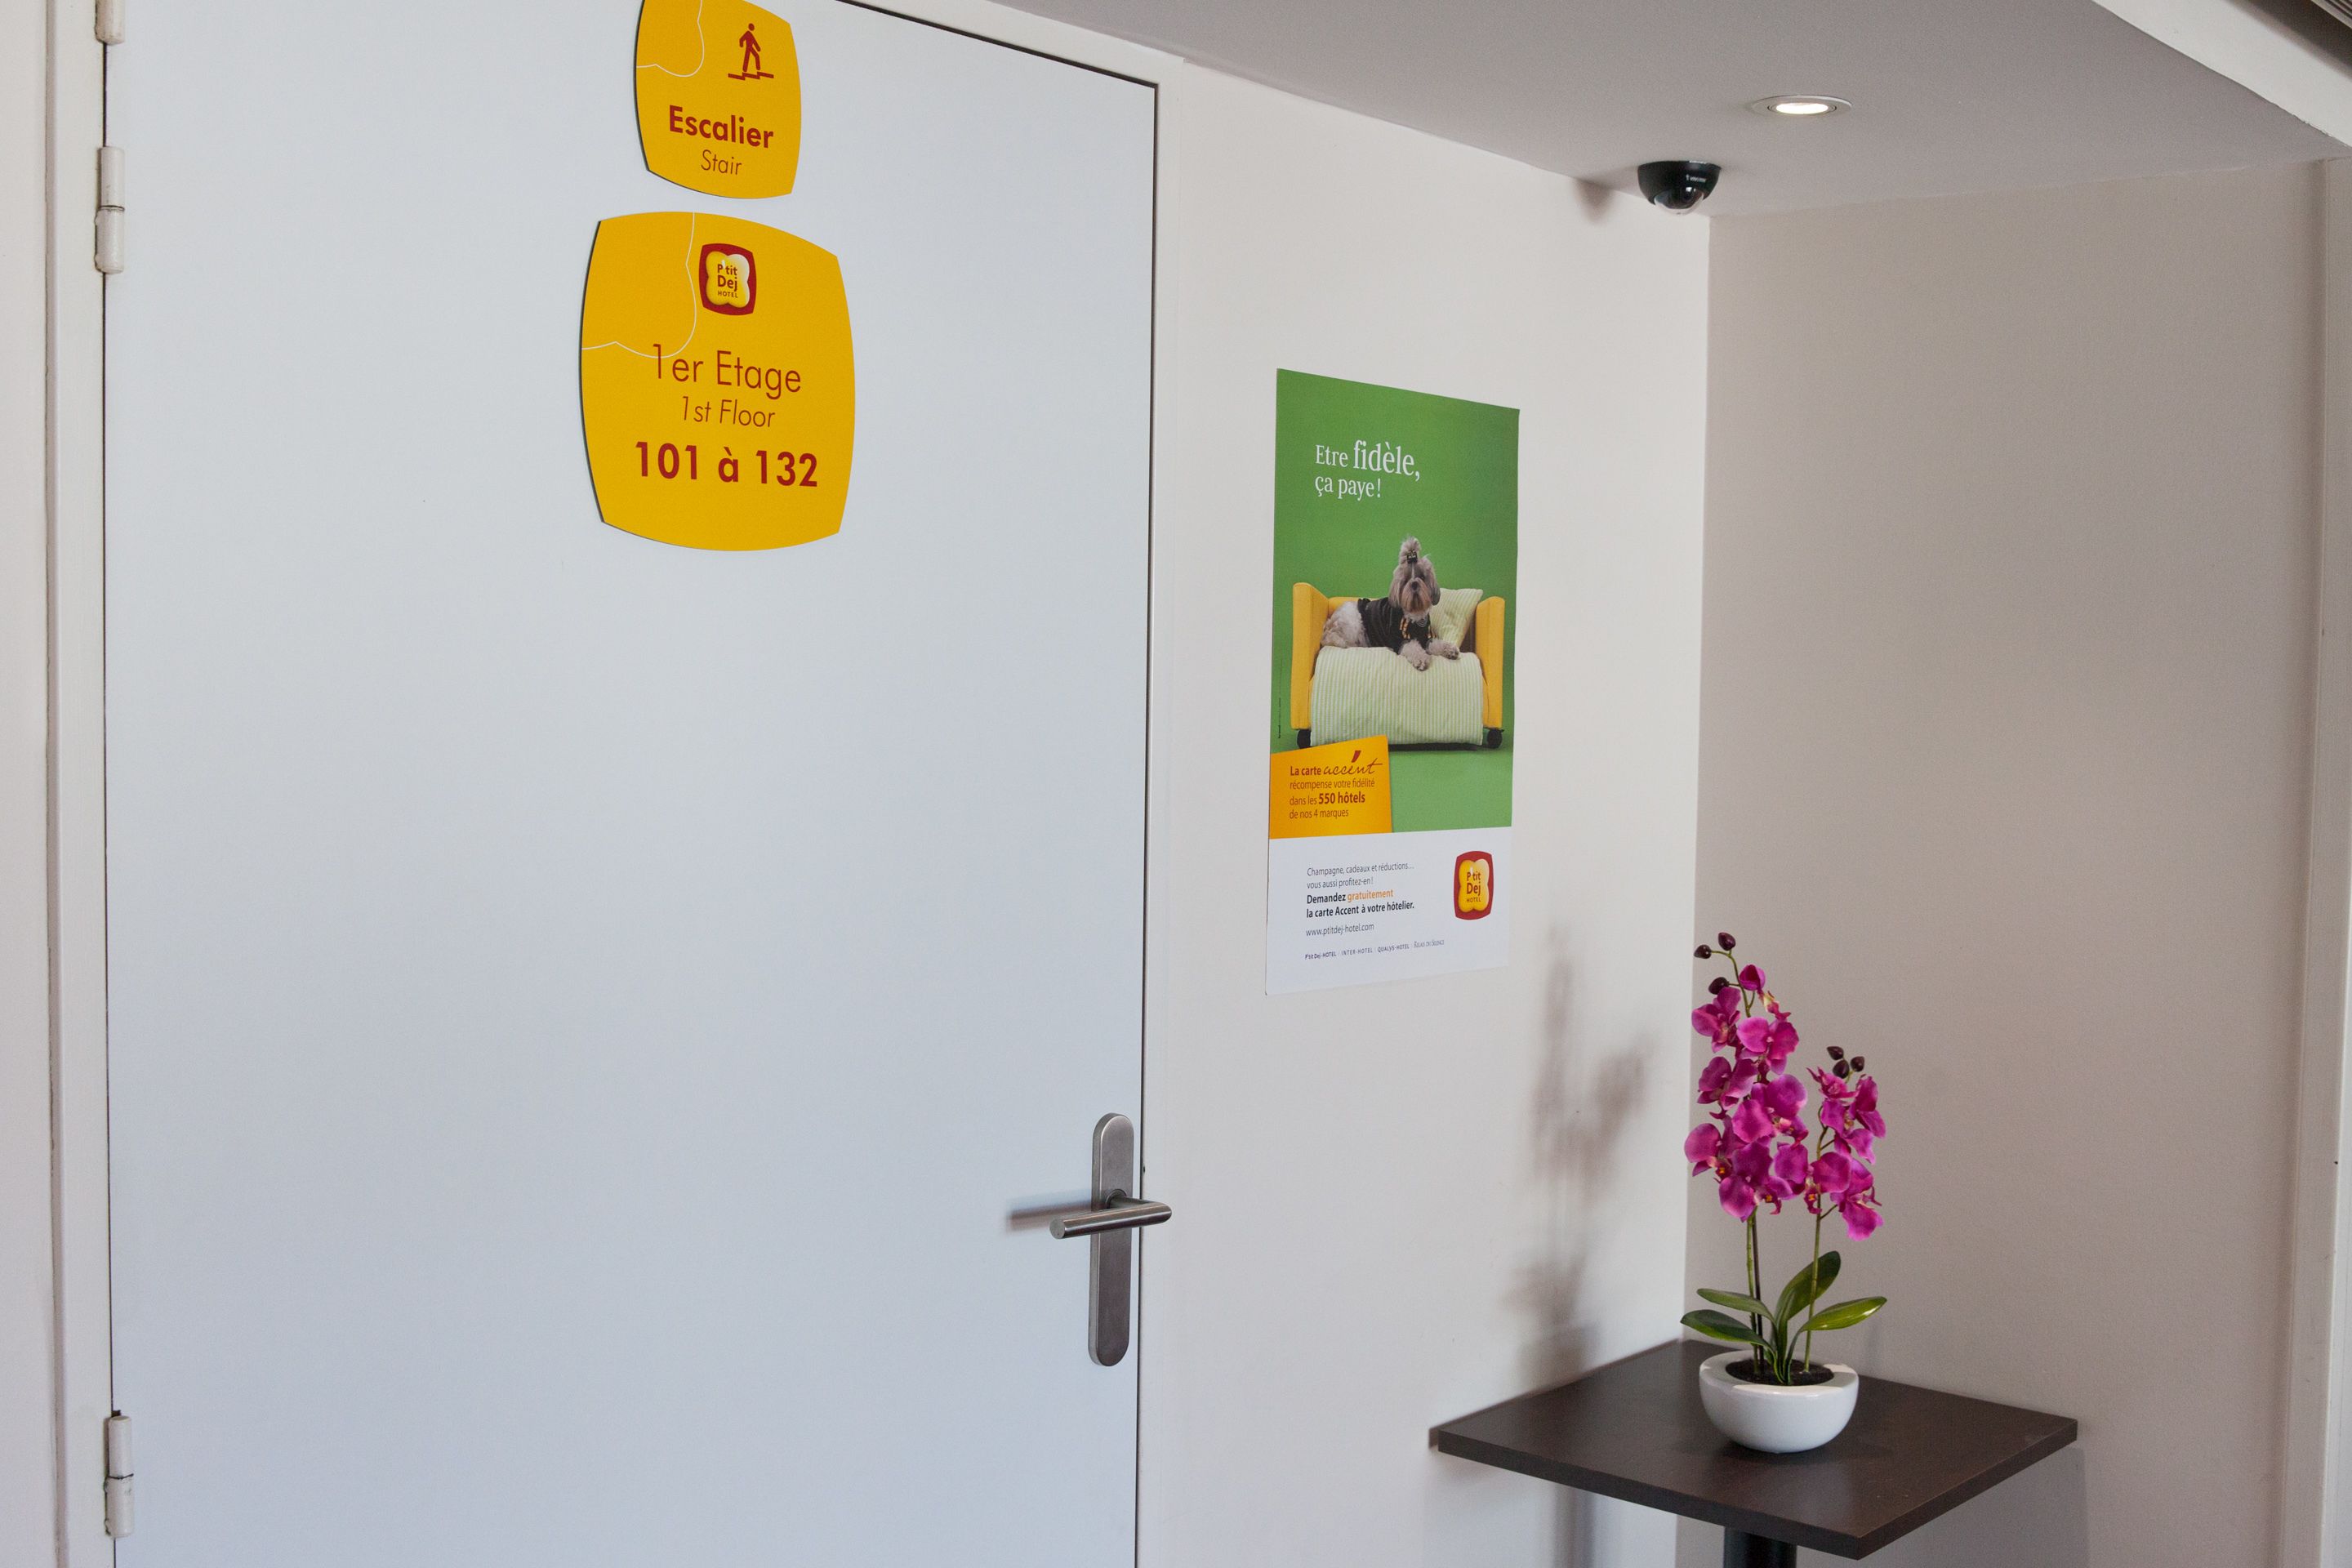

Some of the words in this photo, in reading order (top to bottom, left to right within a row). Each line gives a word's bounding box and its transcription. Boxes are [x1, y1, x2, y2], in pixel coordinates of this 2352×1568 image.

[669, 104, 774, 149] Escalier
[701, 149, 742, 176] Stair
[717, 274, 737, 292] Dej
[653, 343, 704, 382] 1er
[716, 350, 801, 400] Etage
[682, 396, 711, 423] 1st
[719, 399, 776, 428] Floor
[635, 441, 697, 480] 101
[718, 446, 739, 483] à
[755, 450, 817, 488] 132
[1315, 444, 1348, 468] Etre
[1352, 439, 1420, 482] fidèle,
[1314, 475, 1334, 497] ça
[1290, 766, 1299, 776] La
[1301, 768, 1321, 776] carte
[1290, 779, 1332, 791] récompense
[1334, 781, 1351, 789] votre
[1352, 777, 1375, 788] fidélité
[1290, 796, 1306, 805] dans
[1307, 795, 1317, 805] les
[1318, 793, 1336, 804] 550
[1338, 791, 1365, 804] hôtels
[1290, 809, 1298, 819] de
[1299, 811, 1312, 819] nos
[1313, 809, 1319, 818] 4
[1320, 809, 1349, 819] marques
[1307, 868, 1345, 877] Champagne,
[1346, 865, 1370, 873] cadeaux
[1307, 881, 1321, 889] vous
[1322, 880, 1338, 888] aussi
[1466, 881, 1481, 896] Dej
[1307, 893, 1346, 904] Demandez
[1347, 889, 1394, 902] gratuitement
[1307, 909, 1313, 918] la
[1315, 909, 1334, 917] carte
[1334, 906, 1359, 915] Accent
[1361, 904, 1365, 913] à
[1367, 904, 1386, 913] votre
[1387, 901, 1414, 911] hôtelier.
[1306, 923, 1374, 937] www.ptitdej-hotel.com
[1341, 947, 1373, 956] INTER-HOTEL
